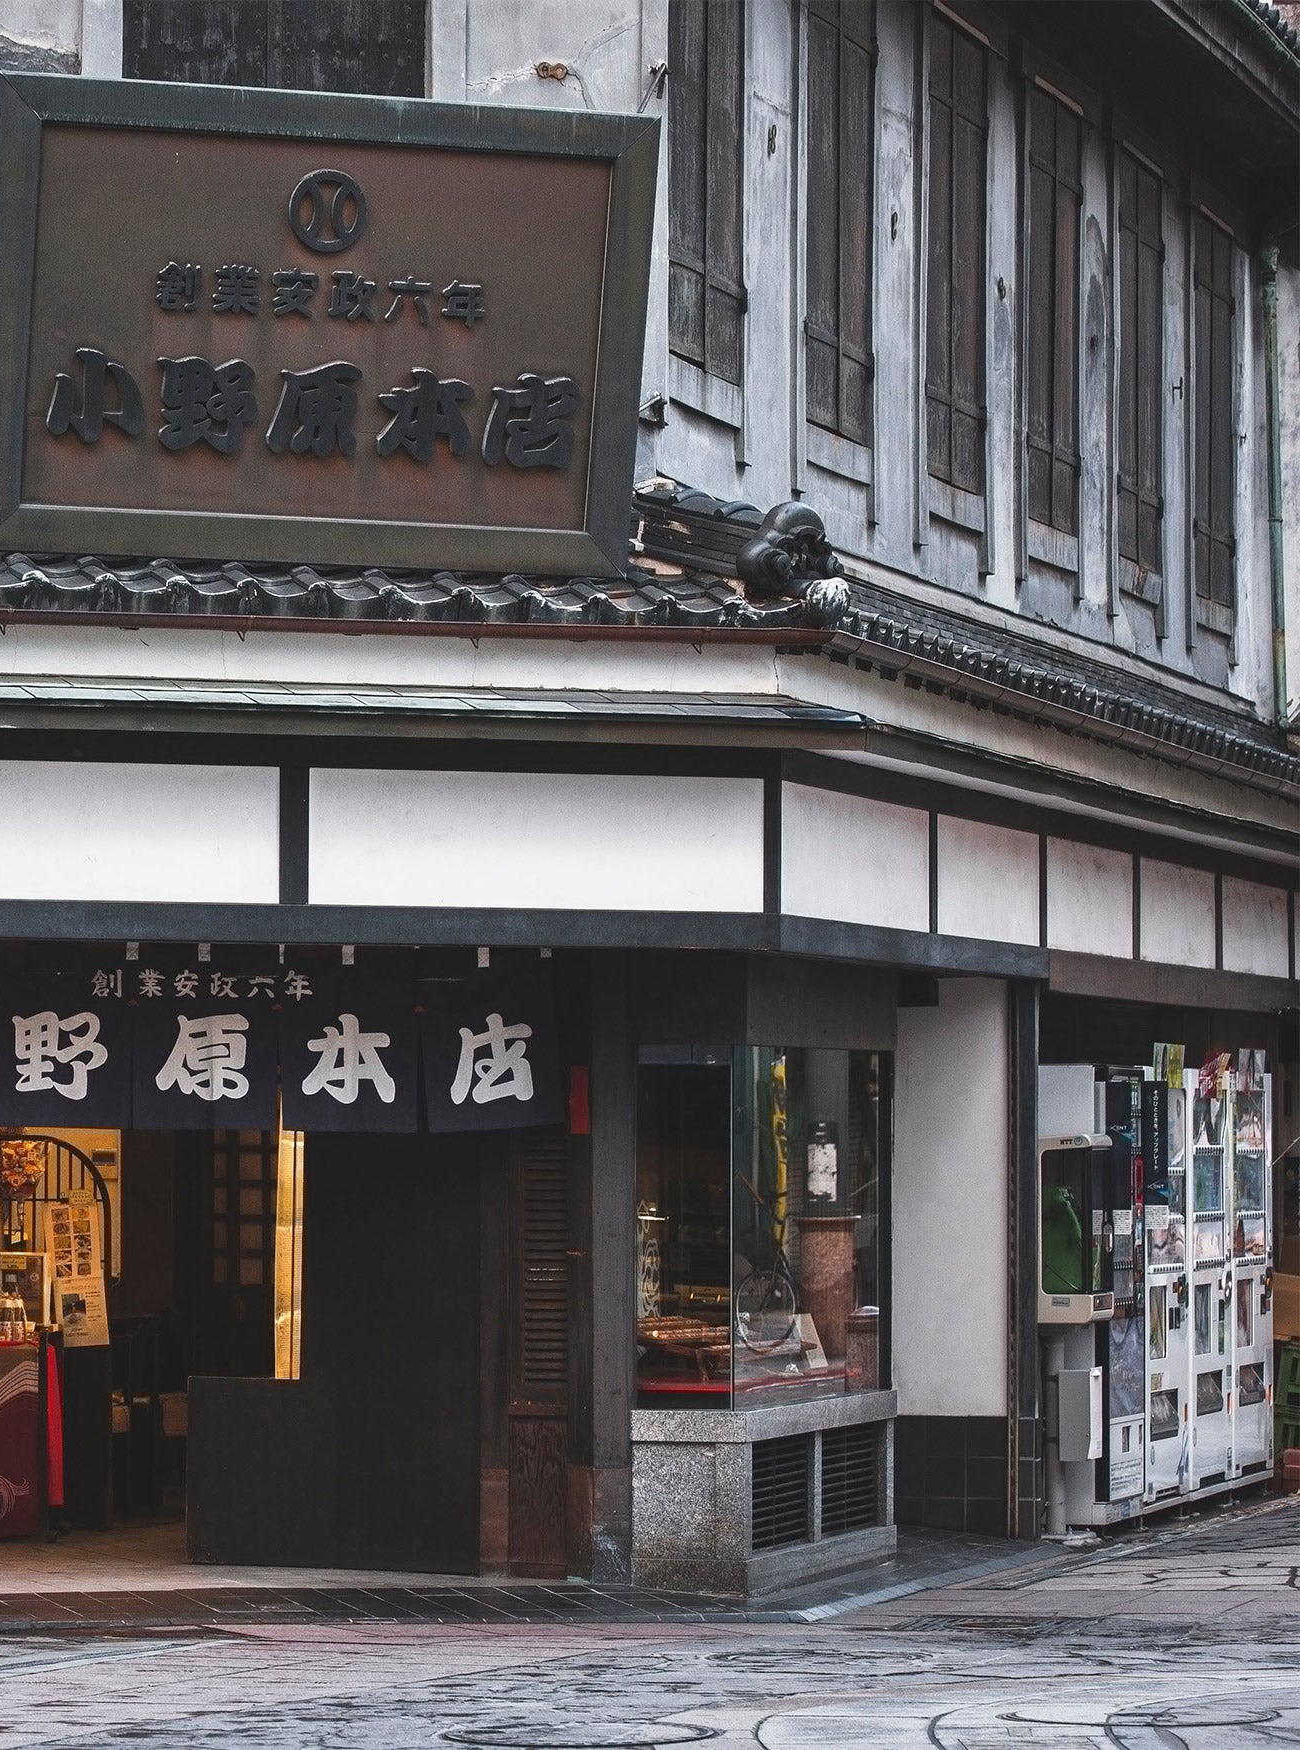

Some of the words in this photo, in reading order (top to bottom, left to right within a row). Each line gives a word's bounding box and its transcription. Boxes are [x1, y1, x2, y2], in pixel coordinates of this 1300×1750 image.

[156, 260, 486, 328] 創業安政六年
[45, 346, 582, 473] 小野原本店
[91, 969, 313, 1001] 創業安政六年
